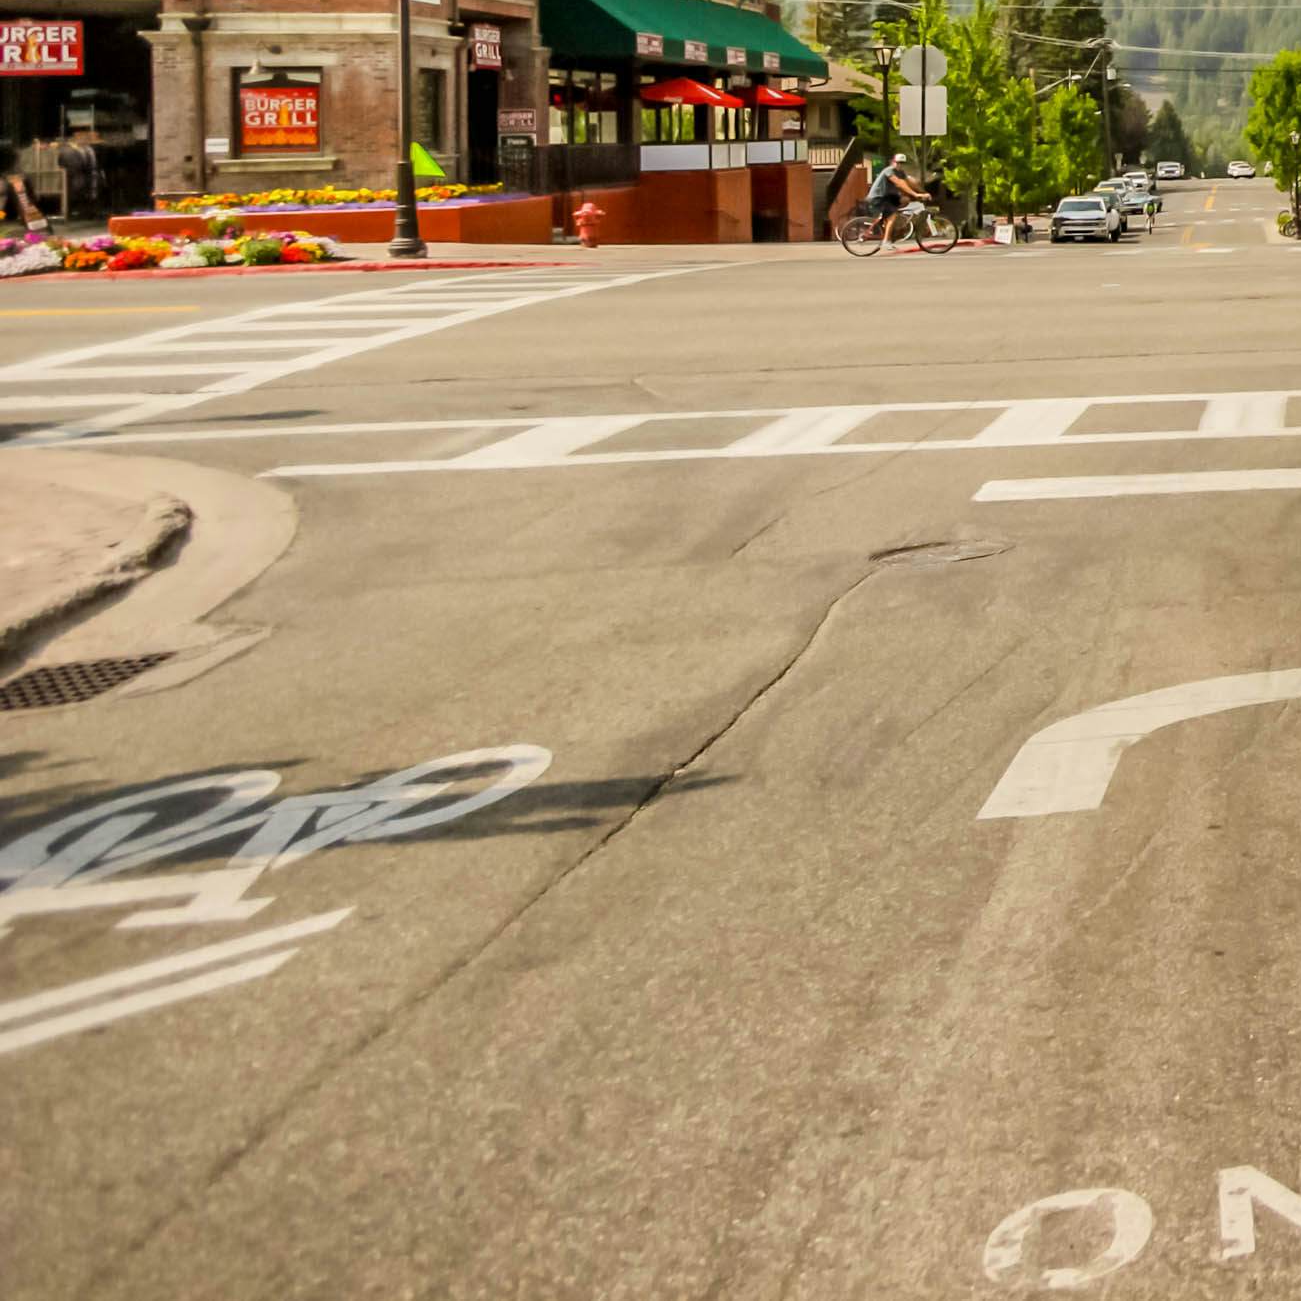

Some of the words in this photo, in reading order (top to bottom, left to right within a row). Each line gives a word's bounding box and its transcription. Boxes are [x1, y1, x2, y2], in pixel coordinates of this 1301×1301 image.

[0, 26, 77, 43] URGER
[0, 44, 78, 63] RILL
[475, 42, 502, 60] GRILL
[244, 98, 317, 111] BURGER
[244, 111, 317, 126] GRILL
